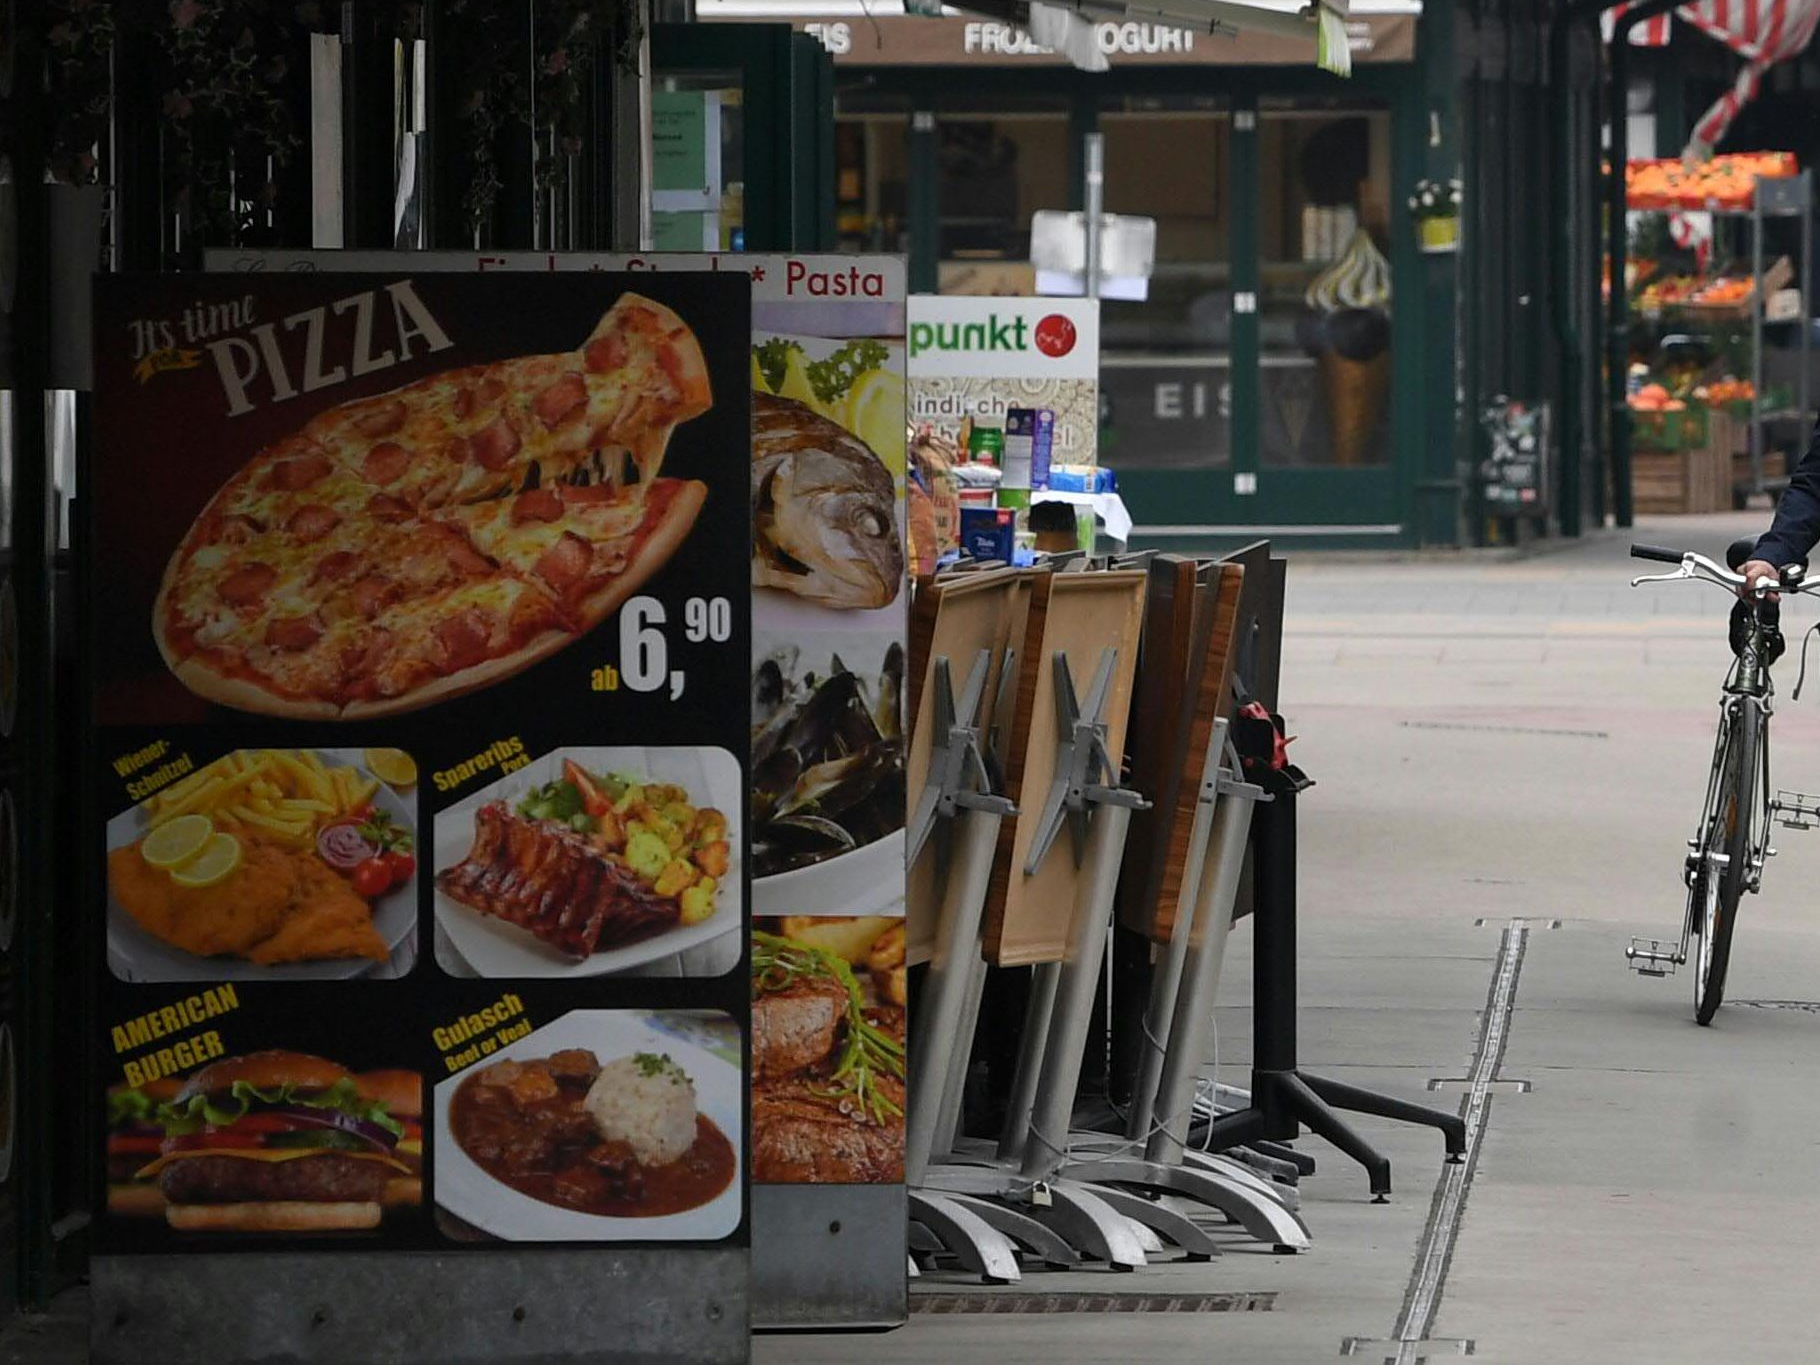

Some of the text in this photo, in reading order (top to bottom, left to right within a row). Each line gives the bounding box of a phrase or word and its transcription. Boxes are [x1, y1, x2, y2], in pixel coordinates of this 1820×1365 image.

[786, 261, 884, 297] Pasta
[180, 294, 256, 343] time
[909, 313, 1028, 358] punkt
[205, 278, 455, 418] PIZZA
[591, 664, 619, 692] ab
[112, 740, 170, 778] Wiener-
[126, 752, 194, 801] Schnitzel
[432, 736, 524, 792] Spareribs
[500, 752, 531, 776] Pork
[111, 982, 239, 1054] AMERICAN
[432, 993, 524, 1052] Gulasch
[123, 1030, 224, 1089] BURGER
[444, 1018, 533, 1073] Beef or Veal
